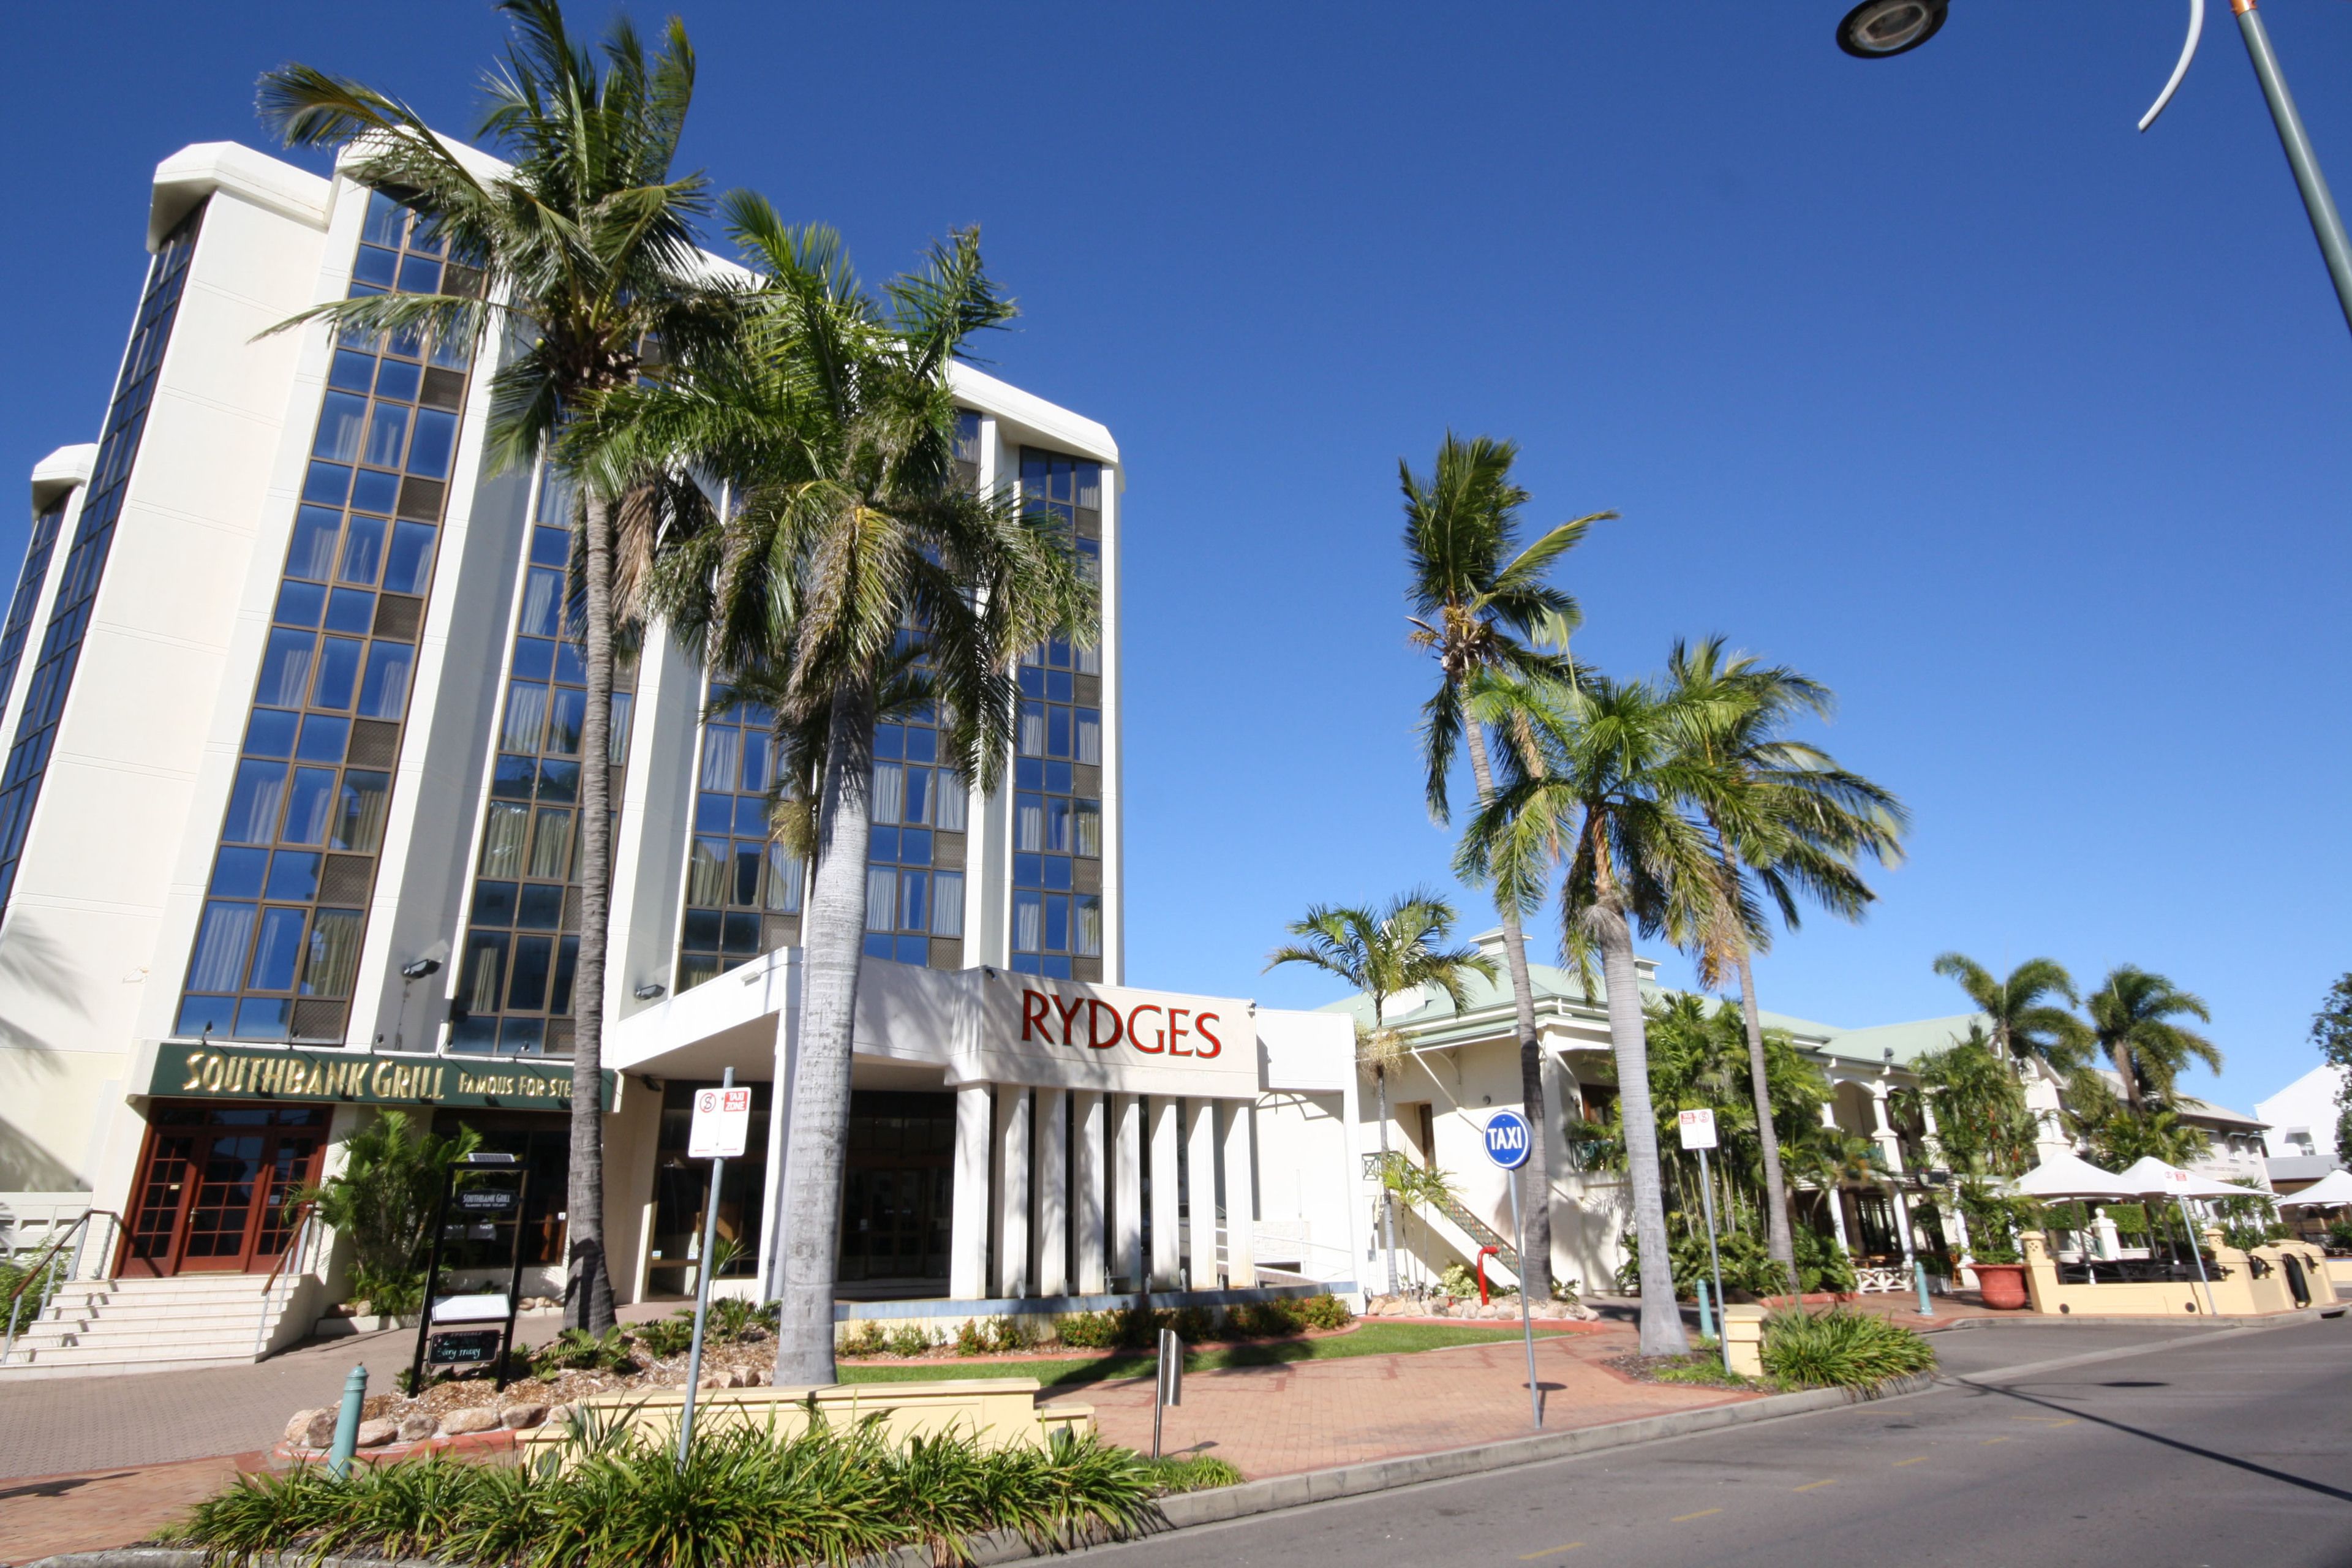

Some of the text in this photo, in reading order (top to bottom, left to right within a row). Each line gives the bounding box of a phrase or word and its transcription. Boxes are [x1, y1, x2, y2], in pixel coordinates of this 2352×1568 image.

[1021, 989, 1222, 1059] RYDGES
[183, 1051, 445, 1099] SOUTHBANK GRILL
[458, 1072, 573, 1098] FAMOUS FOR STE
[725, 1101, 745, 1110] ZONE
[728, 1092, 745, 1101] TAXI
[1487, 1126, 1523, 1150] TAXI
[462, 1193, 510, 1203] SOUTHBANK GRILL
